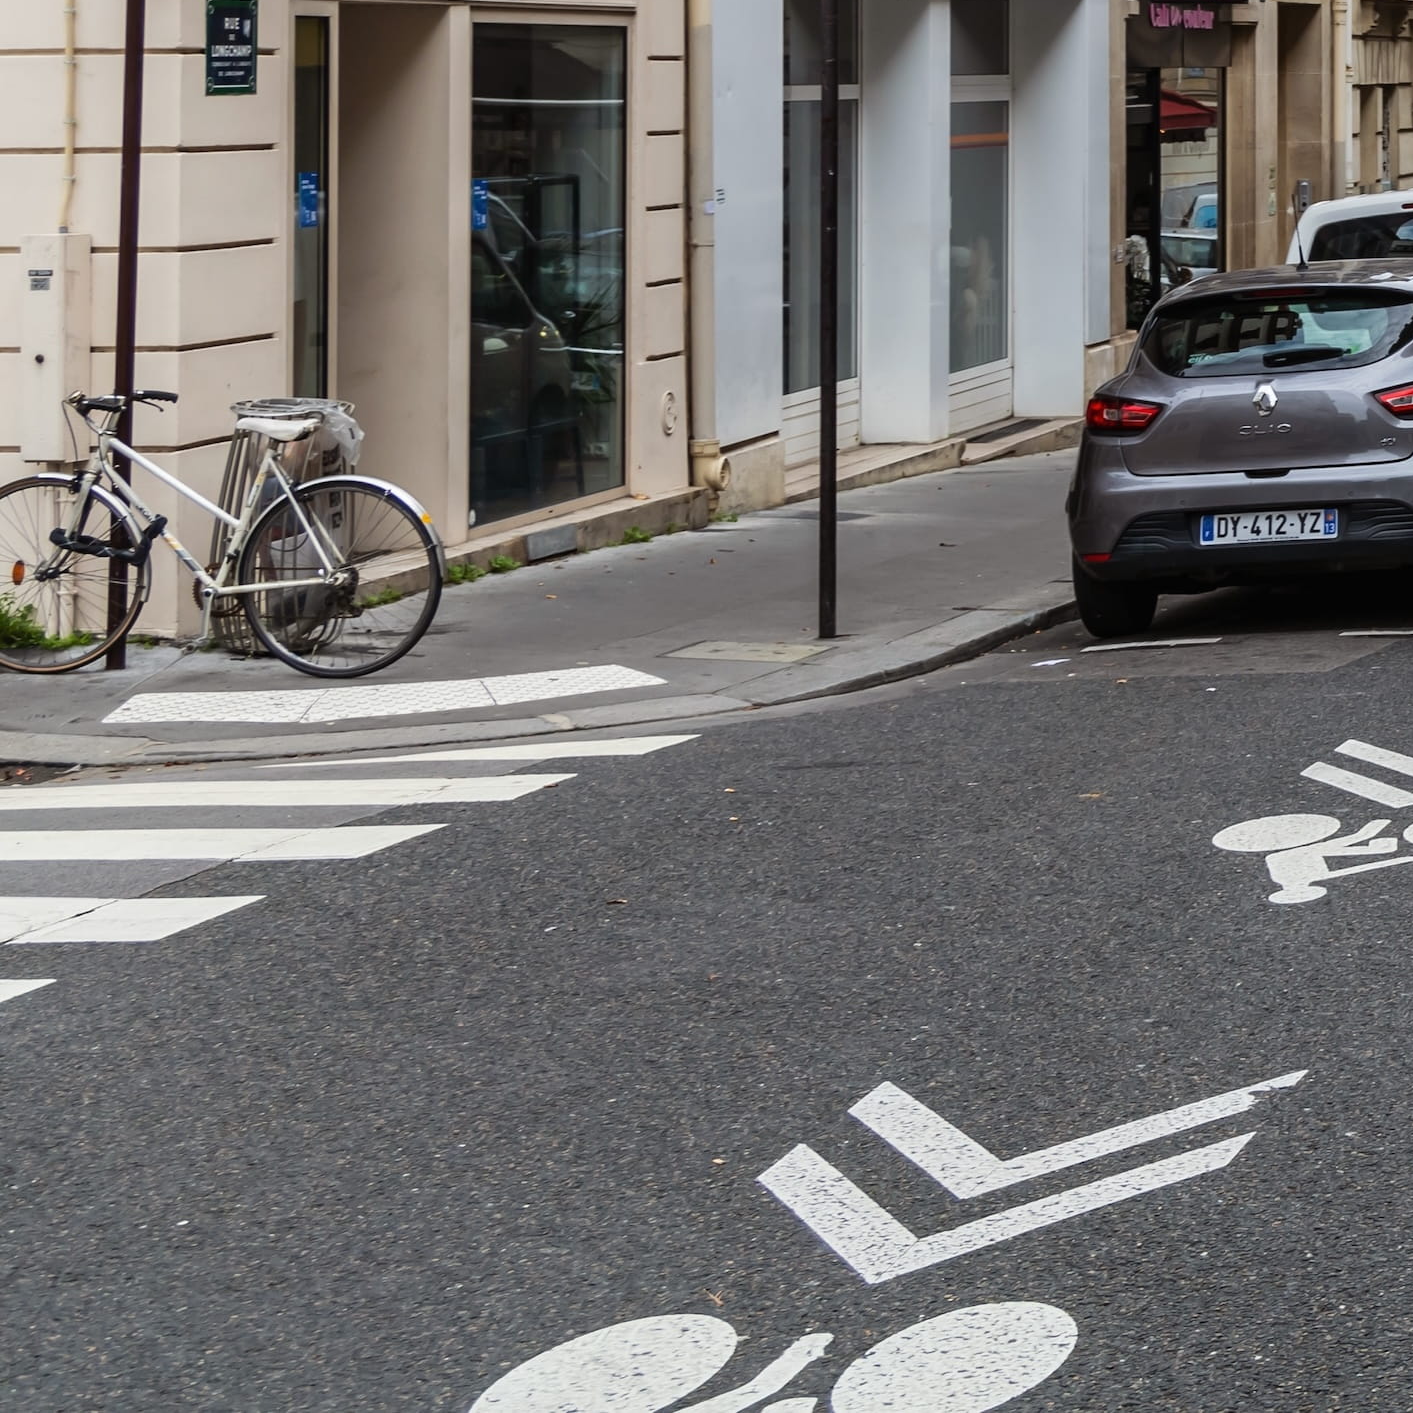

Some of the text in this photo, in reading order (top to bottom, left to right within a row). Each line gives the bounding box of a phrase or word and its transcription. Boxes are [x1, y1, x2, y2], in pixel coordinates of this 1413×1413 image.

[224, 17, 240, 30] RUE
[211, 45, 252, 57] LONGCHAMP
[1239, 423, 1292, 435] CLIO
[1216, 512, 1321, 539] DY-412-YZ
[1325, 522, 1335, 534] 13
